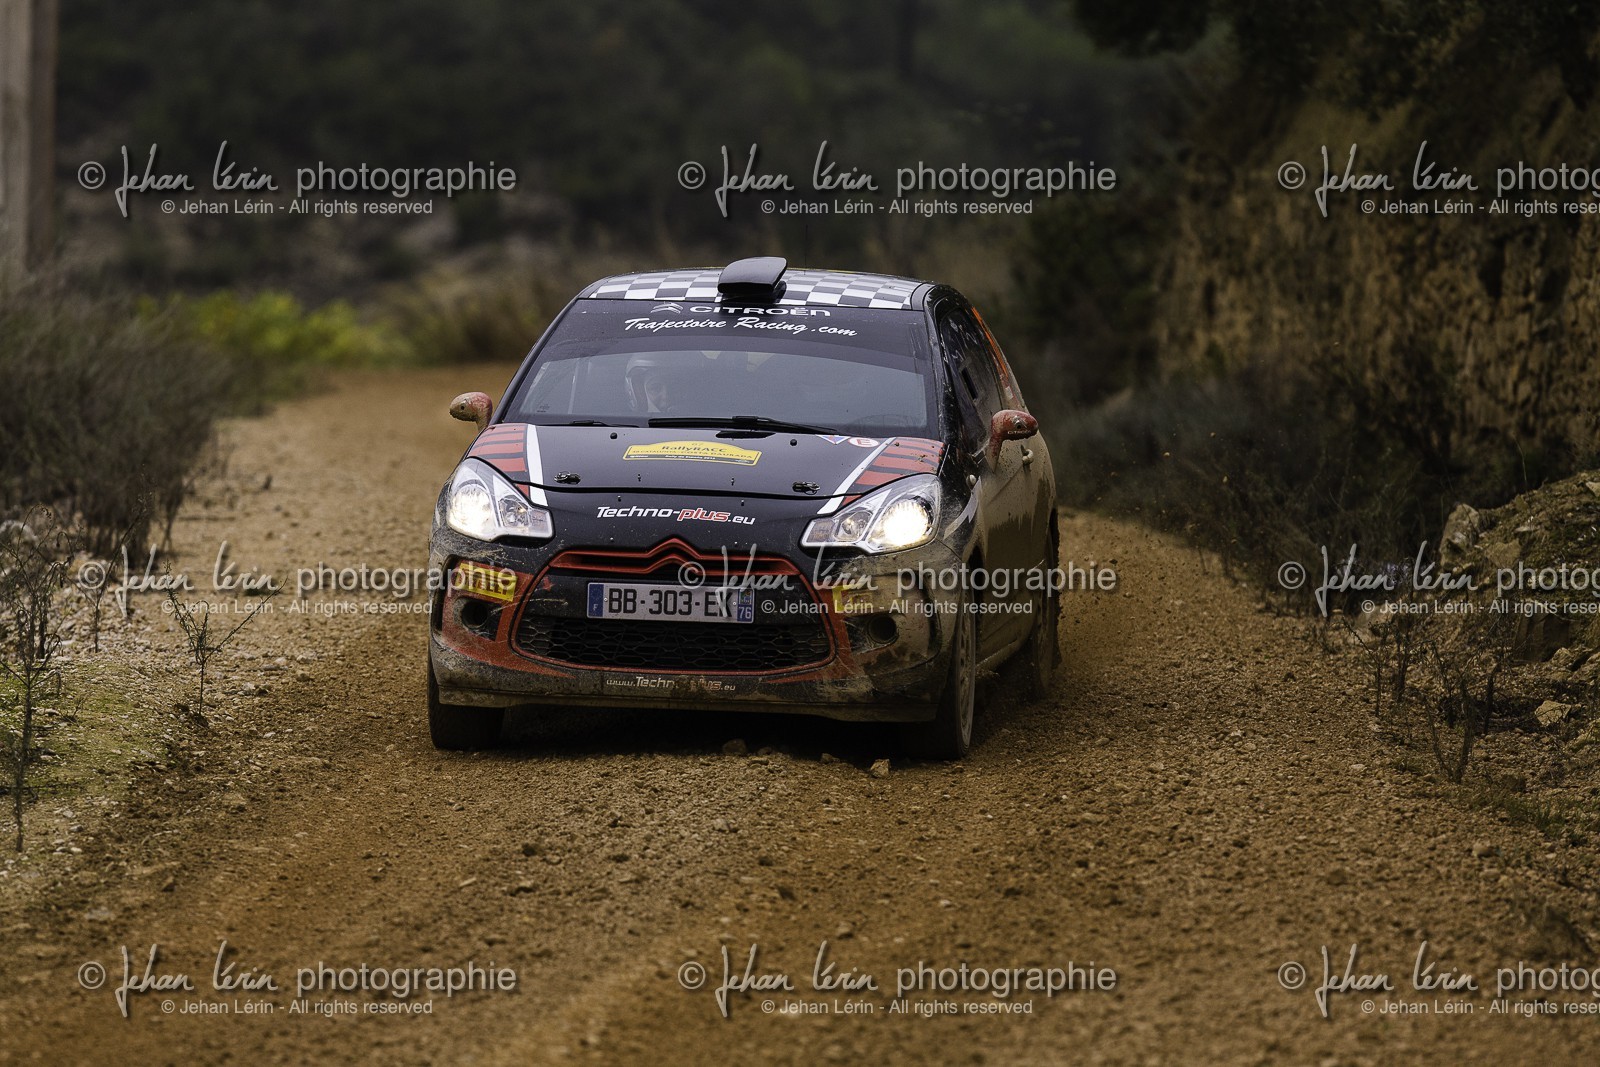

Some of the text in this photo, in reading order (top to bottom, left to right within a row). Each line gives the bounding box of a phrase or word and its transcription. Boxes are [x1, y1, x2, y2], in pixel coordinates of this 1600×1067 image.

[624, 316, 858, 336] Trajectoire Racing .com
[597, 506, 755, 525] Techno-plus.eu
[738, 606, 752, 619] 76
